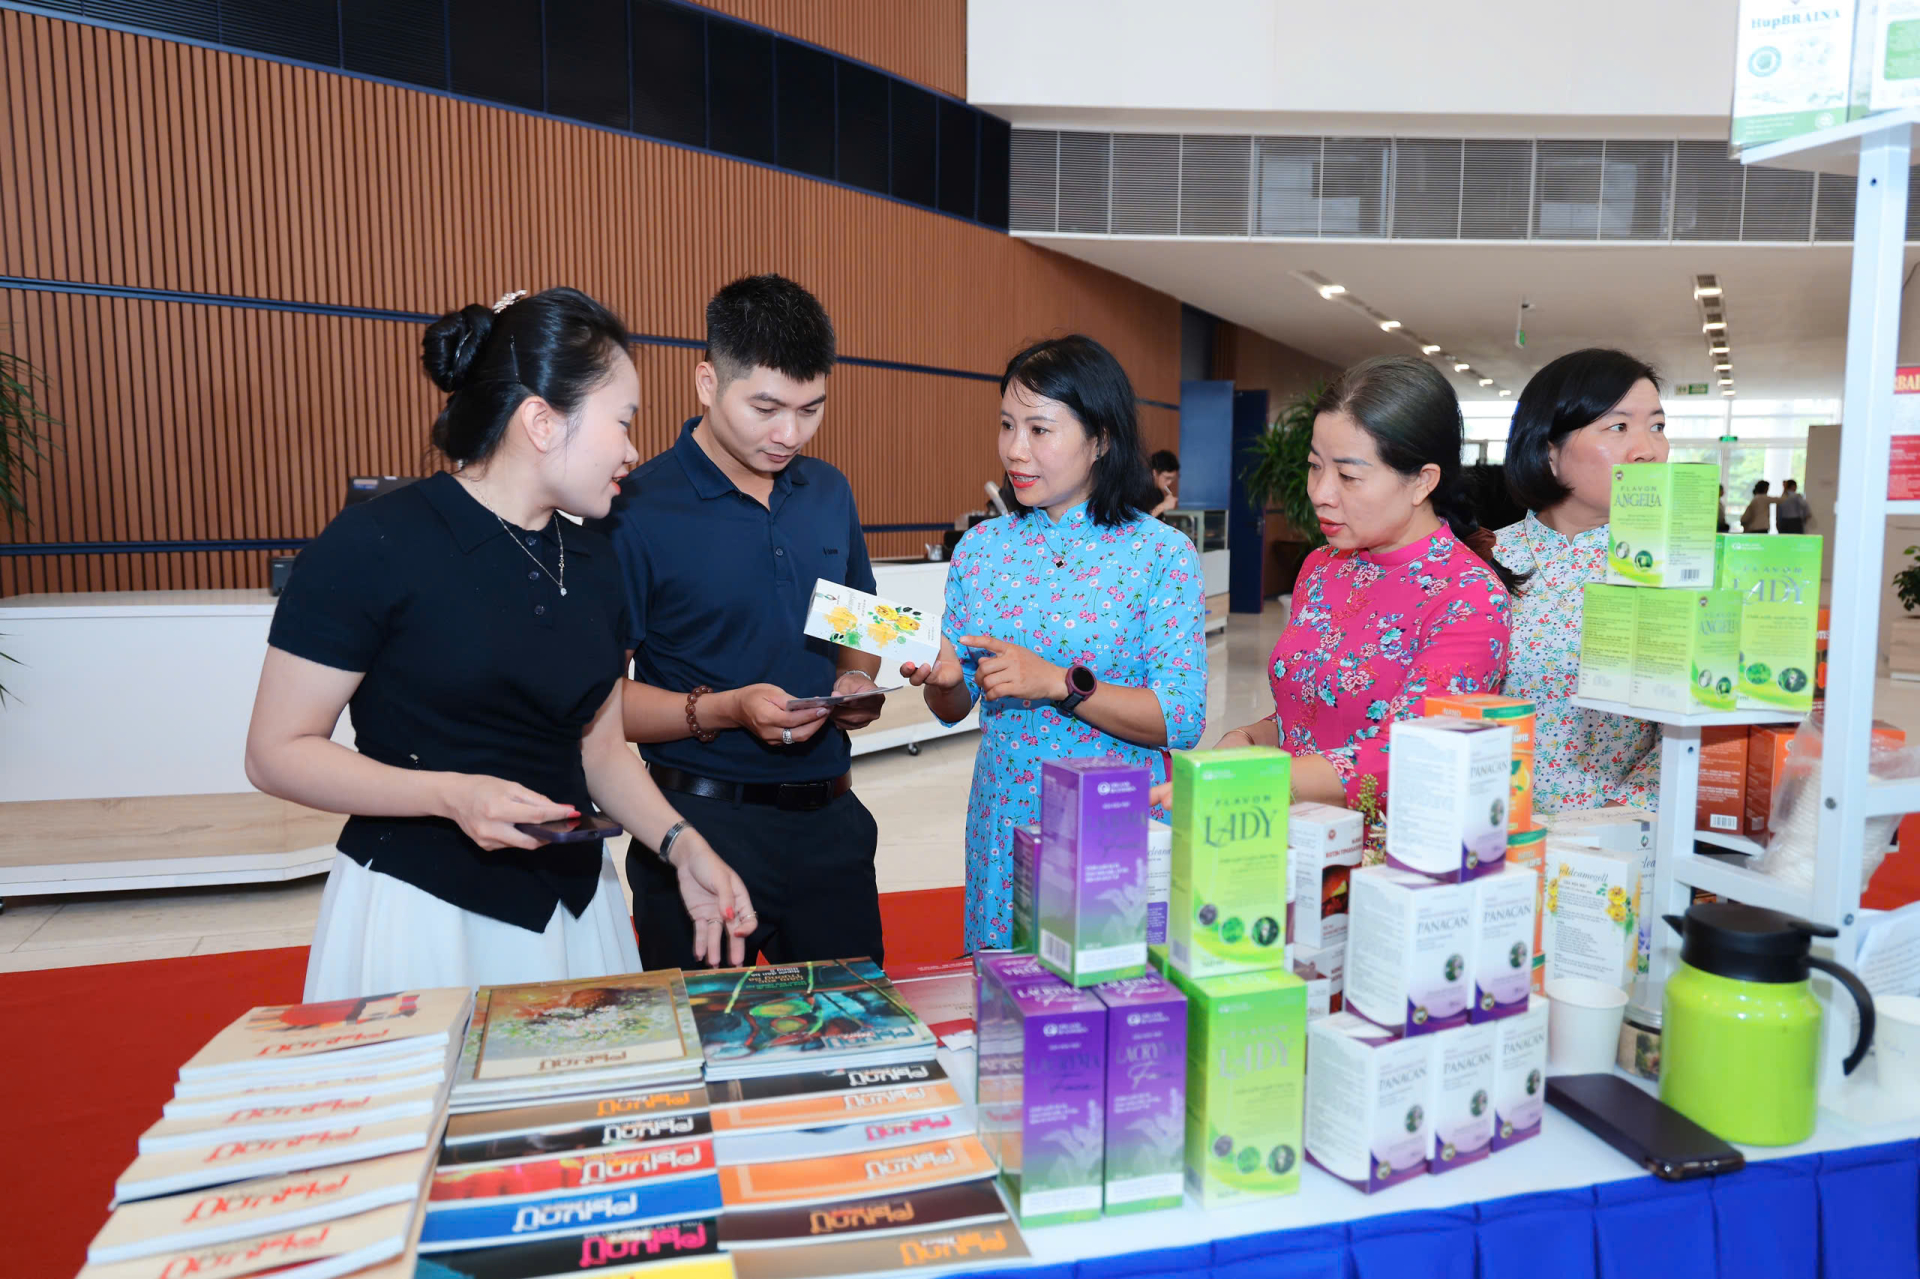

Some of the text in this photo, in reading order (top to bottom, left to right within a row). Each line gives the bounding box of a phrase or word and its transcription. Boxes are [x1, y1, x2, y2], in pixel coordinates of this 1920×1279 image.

[1203, 806, 1277, 848] LADY
[1416, 915, 1470, 935] PANACAN
[1483, 903, 1532, 924] PANACAN
[1502, 1033, 1545, 1056] PANACAN
[1218, 1036, 1294, 1080] LADY
[1443, 1052, 1492, 1075] PANACAN
[1379, 1066, 1428, 1092] PANACAN
